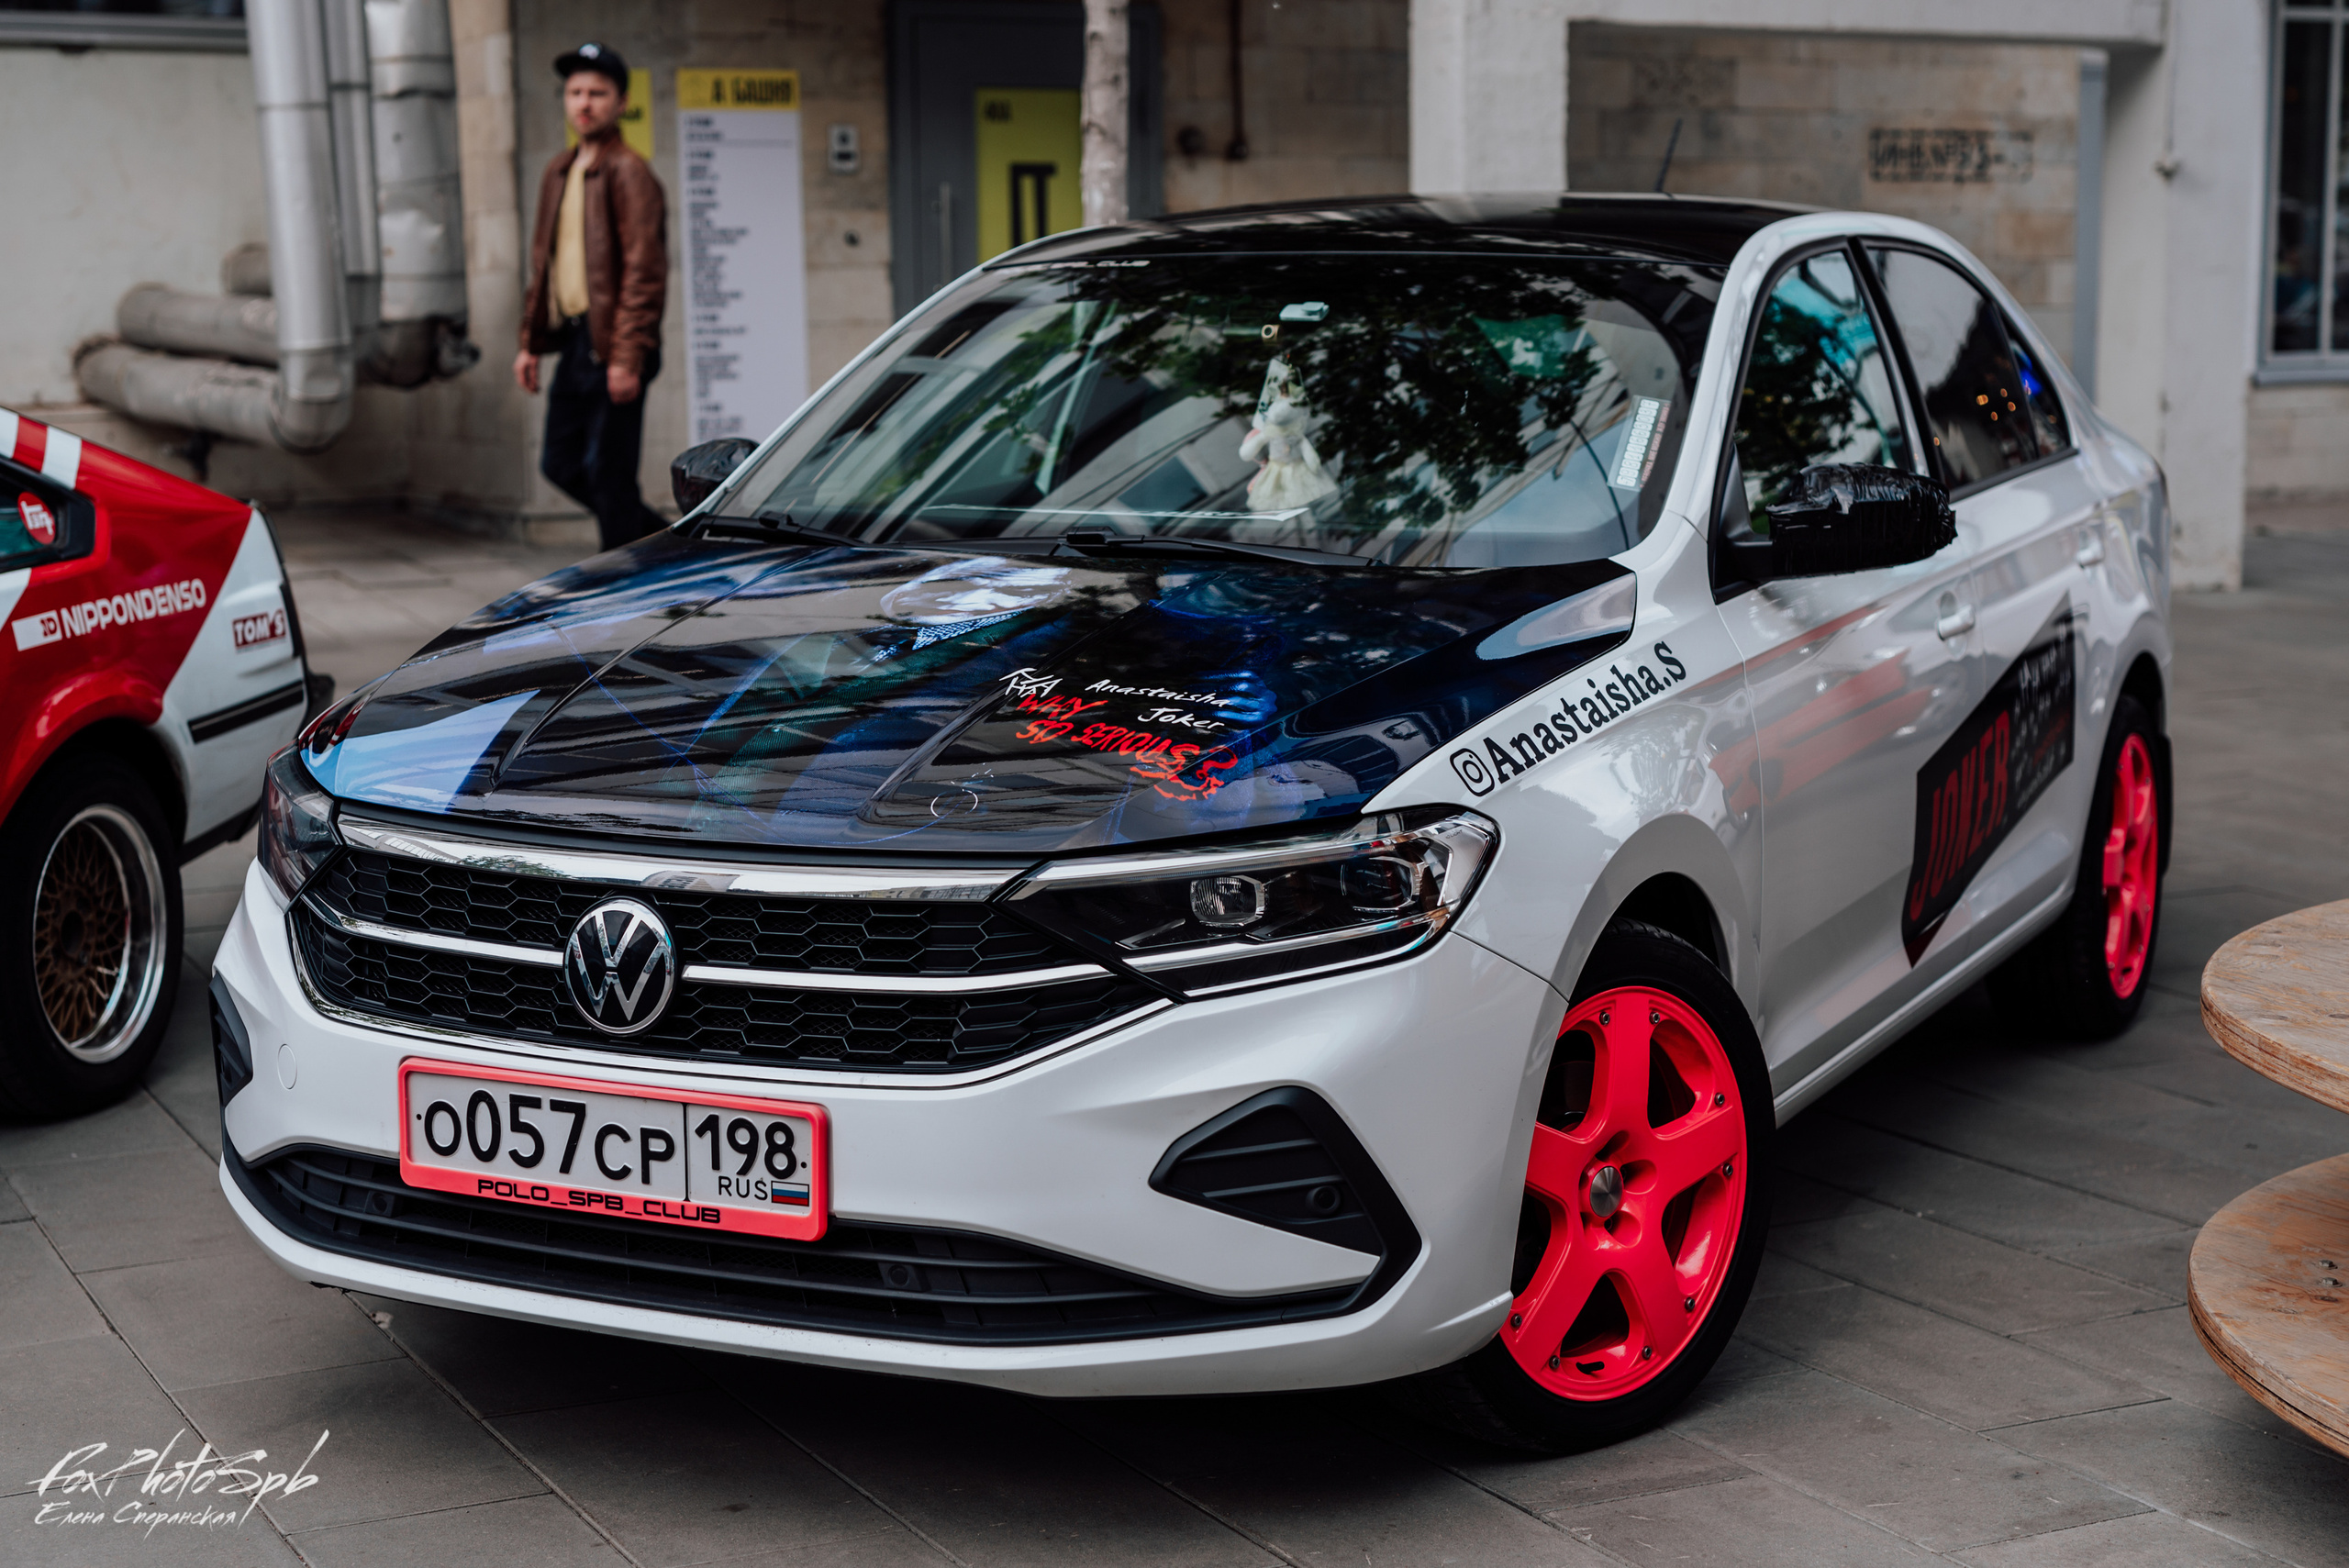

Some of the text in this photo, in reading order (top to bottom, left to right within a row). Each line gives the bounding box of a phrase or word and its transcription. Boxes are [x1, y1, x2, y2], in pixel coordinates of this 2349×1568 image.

[60, 578, 206, 639] NIPPONDENSO
[1015, 694, 1108, 722] WHY
[1085, 679, 1233, 708] Anastaisha
[1016, 719, 1074, 745] SO
[1138, 707, 1225, 730] Joker
[1909, 709, 2010, 922] JOKER
[695, 1113, 797, 1180] 198
[477, 1178, 721, 1225] POLO_SPB_CLUB
[718, 1175, 769, 1201] RUS
